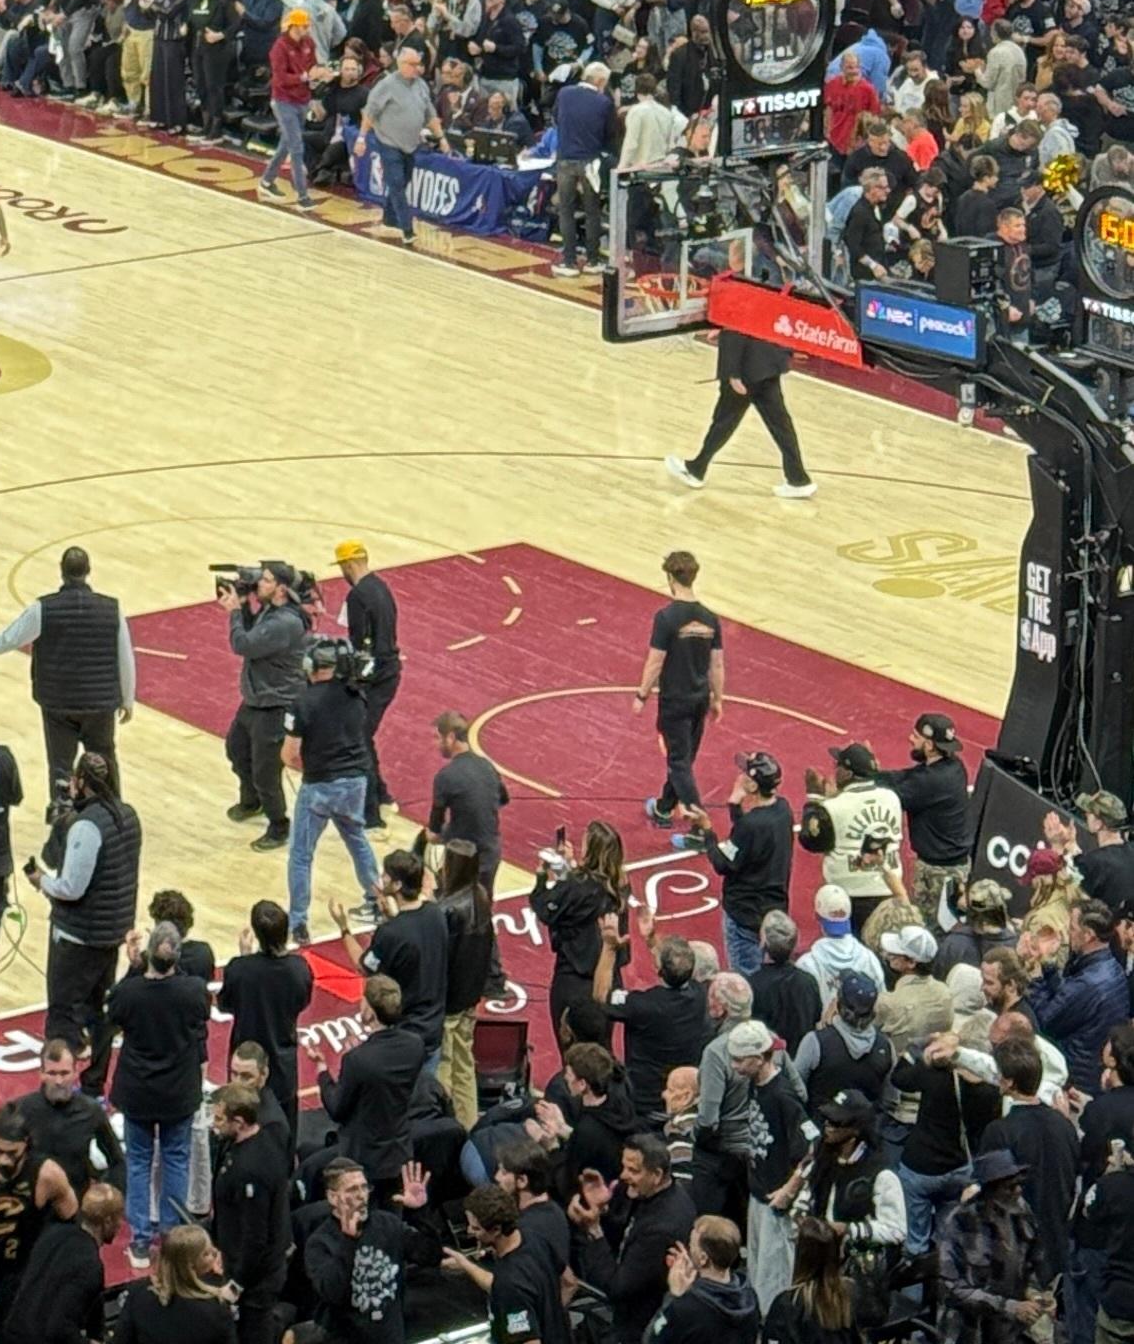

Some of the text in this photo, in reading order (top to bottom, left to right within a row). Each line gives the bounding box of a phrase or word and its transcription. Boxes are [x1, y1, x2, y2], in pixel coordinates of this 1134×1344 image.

[757, 89, 821, 112] TISSOT
[405, 167, 460, 216] YOFFS
[1100, 213, 1134, 249] 15:0
[794, 320, 858, 354] State Farm
[886, 308, 967, 337] NBC peacock
[1026, 562, 1052, 594] GET
[1025, 590, 1052, 625] THE
[1031, 622, 1057, 663] App
